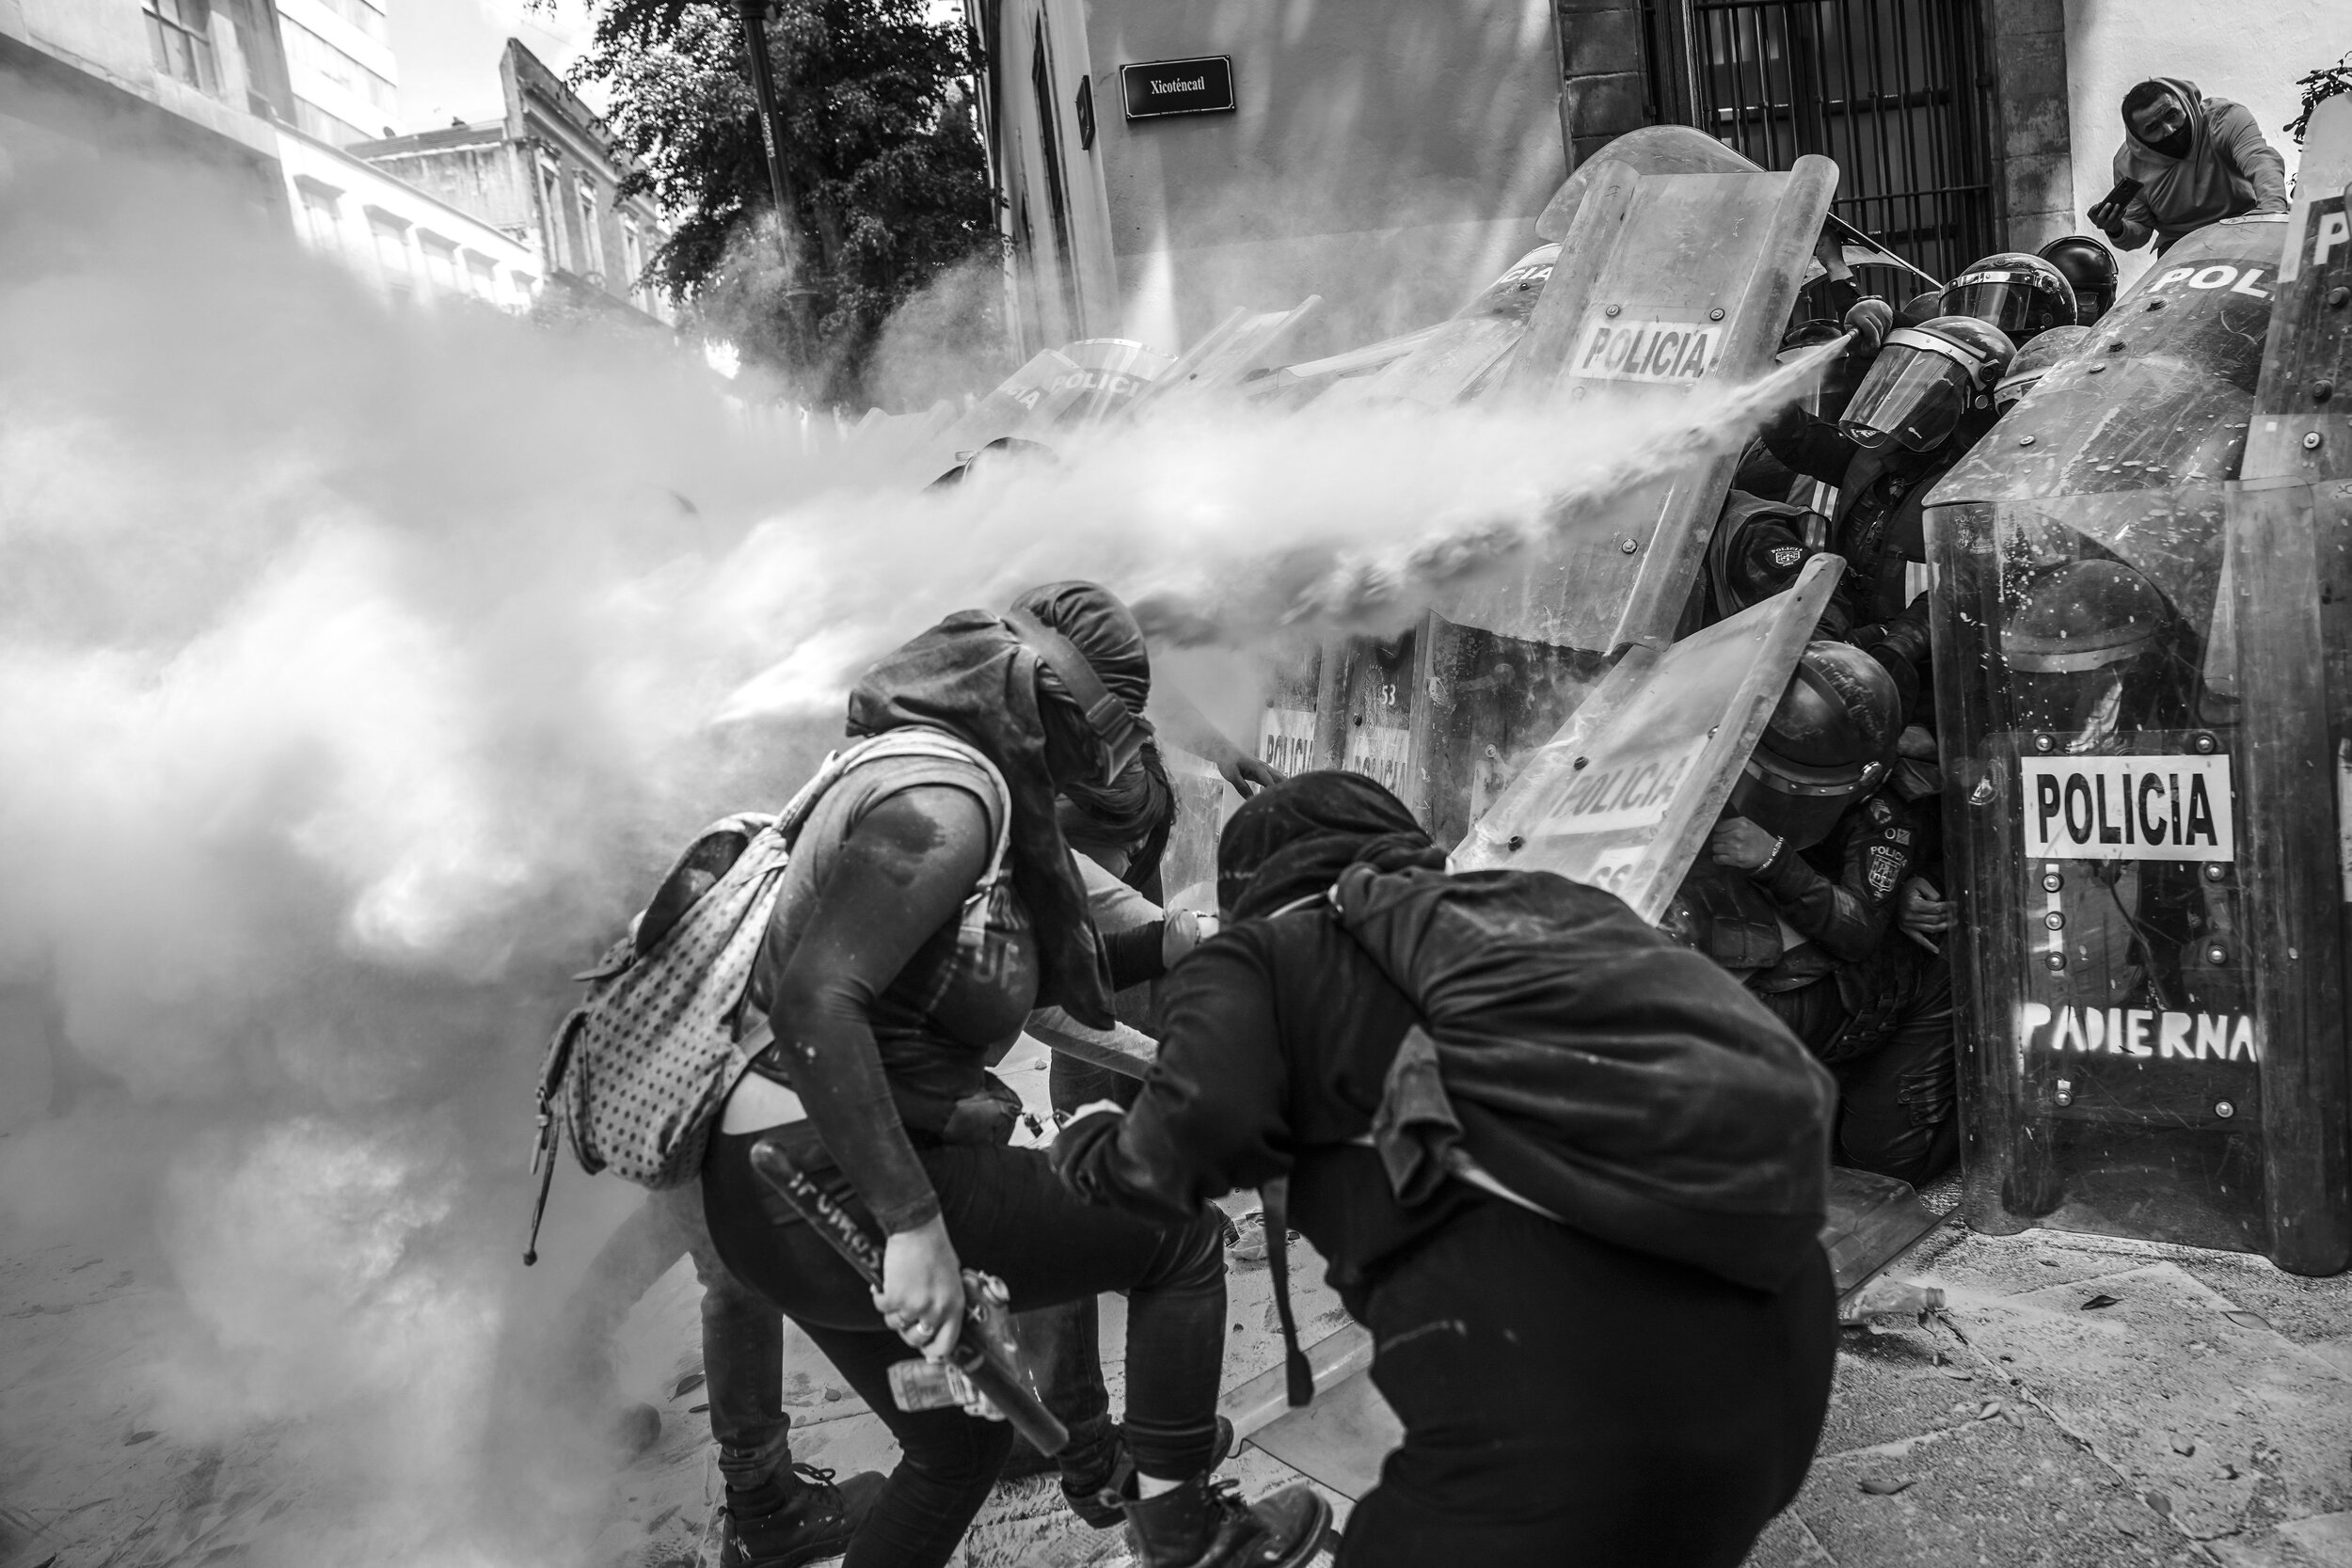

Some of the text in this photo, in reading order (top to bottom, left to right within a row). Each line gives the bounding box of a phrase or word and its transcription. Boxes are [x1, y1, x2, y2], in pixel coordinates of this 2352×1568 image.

[1150, 76, 1205, 94] Xicoténcatl
[2147, 264, 2276, 302] POL
[1581, 327, 1708, 378] POLICIA
[1382, 684, 1397, 705] 53
[1551, 755, 1692, 819] POLICIA
[2036, 772, 2218, 847] POLICIA
[2021, 1002, 2257, 1062] PADIERNA
